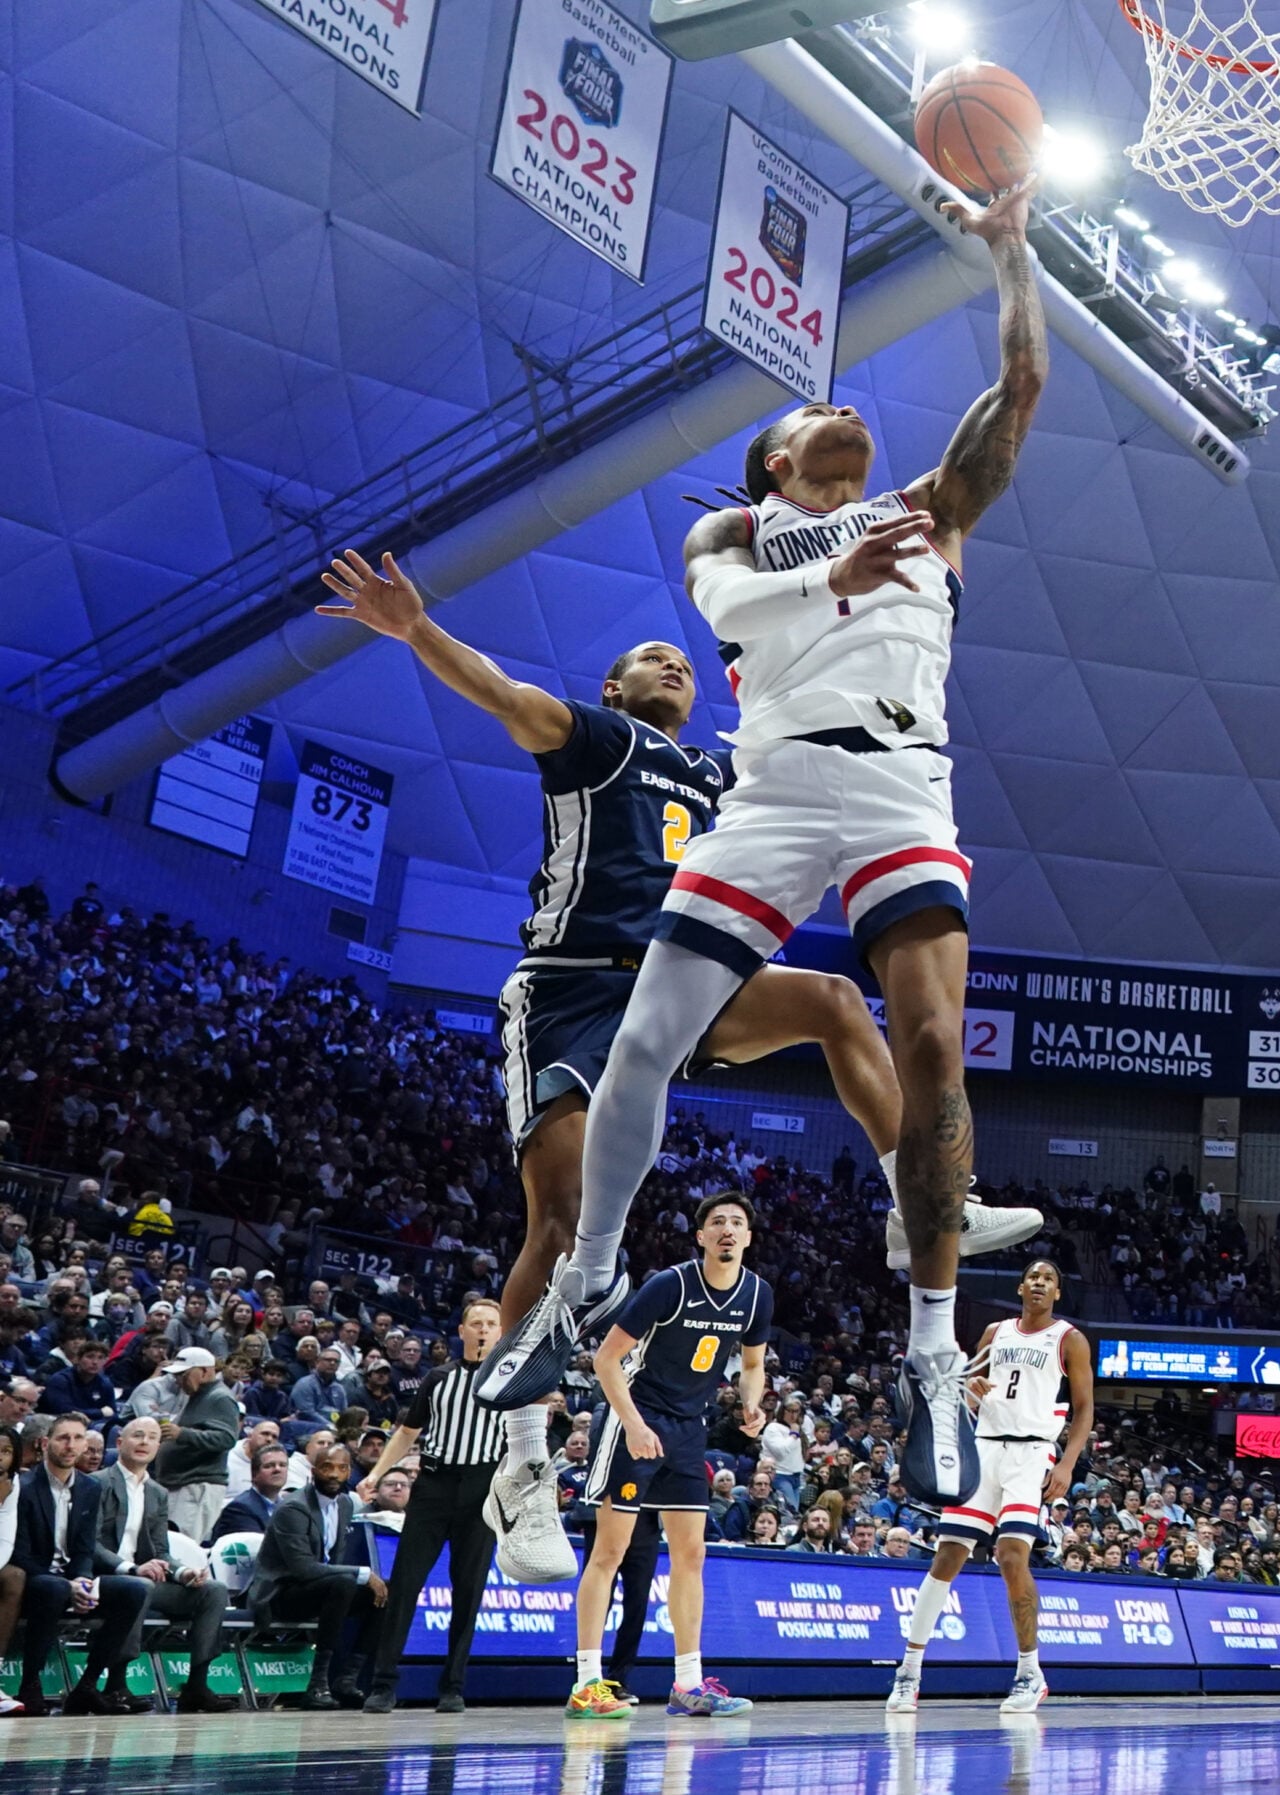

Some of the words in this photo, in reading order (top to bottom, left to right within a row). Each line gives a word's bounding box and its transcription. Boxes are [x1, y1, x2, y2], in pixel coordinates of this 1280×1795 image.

[561, 0, 636, 66] Basketball
[608, 13, 648, 54] Men's
[573, 51, 614, 95] FINAL
[574, 74, 614, 112] FOUR
[517, 89, 637, 205] 2023
[752, 134, 792, 176] UConn
[795, 169, 828, 205] Men's
[524, 145, 622, 232] NATIONAL
[757, 159, 819, 217] Basketball
[512, 167, 627, 261] CHAMPIONS
[769, 204, 798, 236] FINAL
[767, 219, 797, 253] FOUR
[724, 247, 823, 347] 2024
[729, 298, 812, 369] NATIONAL
[719, 318, 816, 396] CHAMPIONS
[309, 763, 328, 778] JIM
[330, 772, 385, 800] CALHOUN
[330, 754, 369, 779] COACH
[641, 771, 676, 792] EAST
[676, 784, 711, 809] TEXAS
[311, 785, 373, 831] 873
[662, 800, 691, 865] 2
[366, 951, 392, 968] 223
[1026, 973, 1112, 1004] WOMEN'S
[1119, 981, 1234, 1014] BASKETBALL
[472, 1017, 485, 1030] 11
[1032, 1021, 1212, 1059] NATIONAL
[1259, 1036, 1280, 1053] 31
[1030, 1049, 1213, 1078] CHAMPIONSHIPS
[784, 1117, 799, 1130] 12
[1078, 1142, 1093, 1155] 13
[1206, 1144, 1235, 1153] NORTH
[116, 1238, 145, 1252] SEC
[326, 1249, 350, 1264] SEC
[357, 1252, 393, 1277] 122
[683, 1319, 711, 1330] EAST
[711, 1321, 743, 1332] TEXAS
[690, 1335, 721, 1373] 8
[789, 1361, 805, 1370] SEC
[993, 1347, 1049, 1371] CONNECTICUT
[1006, 1369, 1021, 1400] 2
[482, 1589, 521, 1609] AUTO
[523, 1592, 573, 1611] GROUP
[790, 1582, 827, 1599] LISTEN
[828, 1584, 842, 1600] TO
[1040, 1595, 1068, 1611] LISTEN
[1067, 1597, 1079, 1611] TO
[510, 1613, 555, 1633] SHOW
[755, 1600, 779, 1617] THE
[779, 1601, 815, 1619] HARTE
[815, 1603, 844, 1619] AUTO
[844, 1604, 881, 1622] GROUP
[1114, 1599, 1170, 1623] UCONN
[776, 1621, 836, 1639] POSTGAME
[837, 1623, 870, 1640] SHOW
[253, 1660, 286, 1676] M&T
